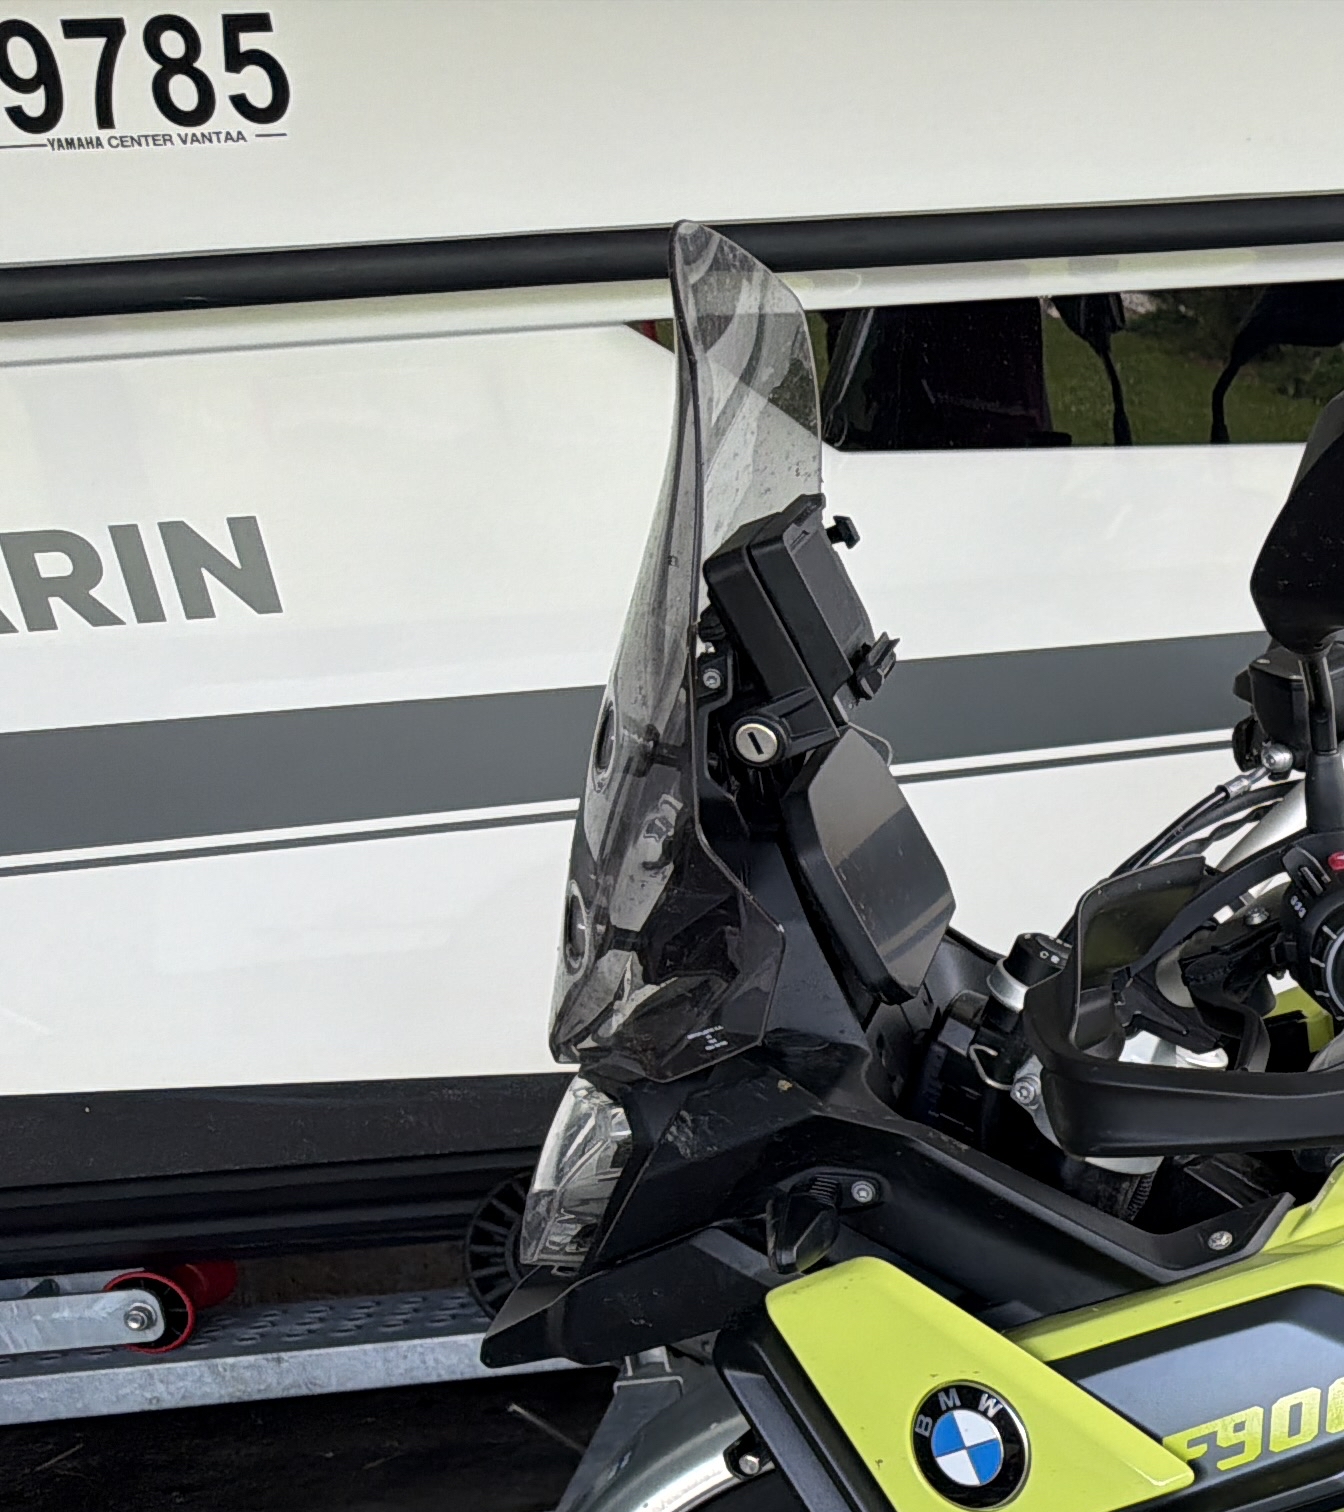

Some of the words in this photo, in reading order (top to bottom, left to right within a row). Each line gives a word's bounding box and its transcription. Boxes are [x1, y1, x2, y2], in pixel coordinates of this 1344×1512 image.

[0, 12, 290, 134] 9785
[47, 136, 104, 151] YAMAHA
[107, 133, 174, 149] CENTER
[177, 131, 247, 146] VANTAA
[0, 516, 283, 634] RIN
[915, 1388, 1003, 1438] BMW
